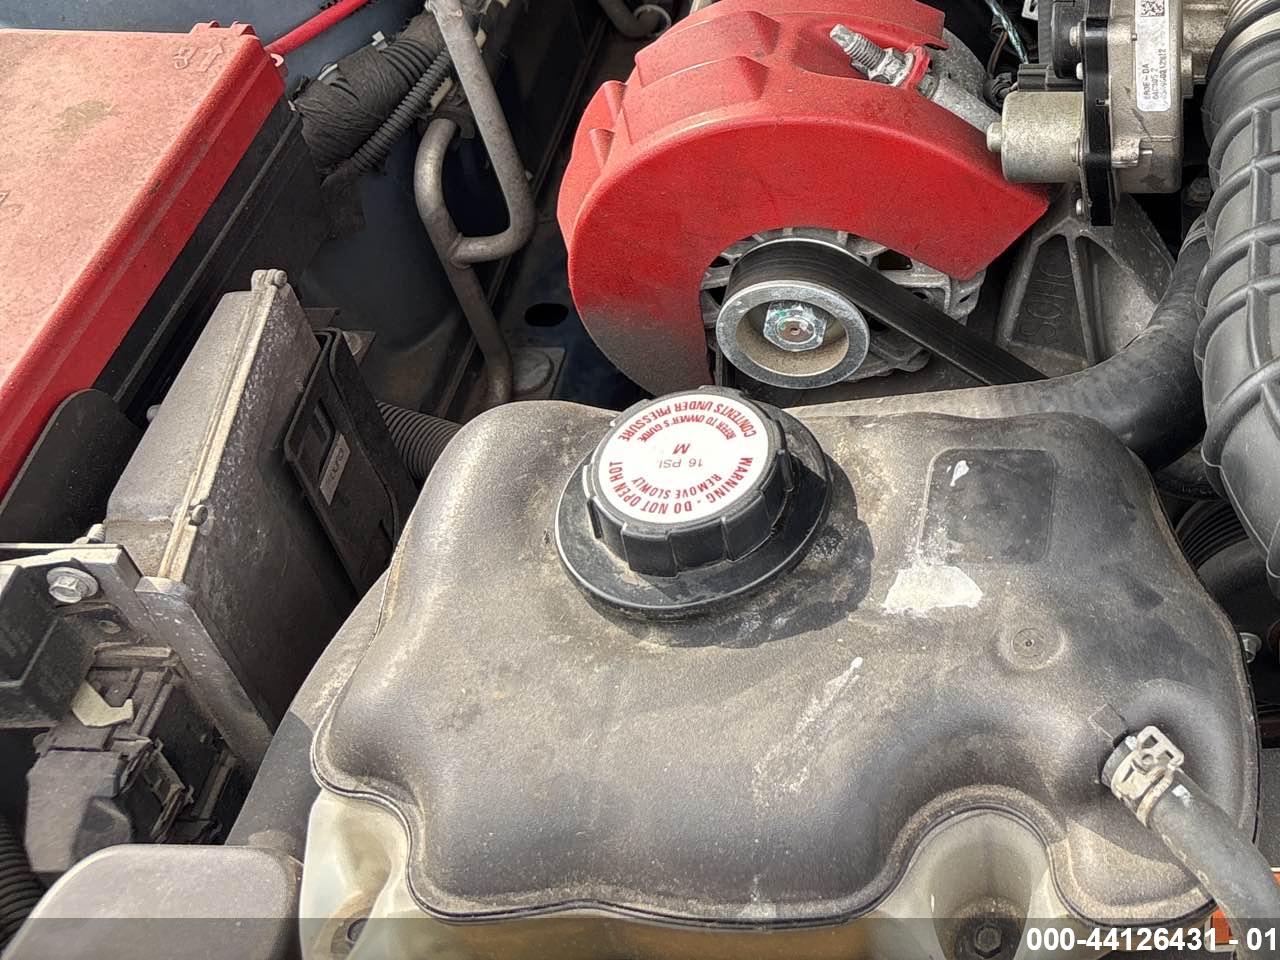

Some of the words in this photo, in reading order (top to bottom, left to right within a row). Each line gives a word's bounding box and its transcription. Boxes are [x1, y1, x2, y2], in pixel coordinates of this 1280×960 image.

[674, 401, 713, 413] UNDER
[618, 405, 672, 442] PRESSURE
[663, 415, 705, 428] OWNER'S
[705, 417, 719, 425] TO
[714, 403, 757, 438] CONTENTS
[638, 424, 663, 442] GUIDE
[716, 422, 737, 440] REFER
[672, 442, 691, 454] M
[608, 460, 624, 483] HOT
[688, 457, 703, 468] 16
[631, 476, 671, 499] SLOWLY
[675, 473, 723, 499] REMOVE
[708, 456, 753, 504] WARNING
[613, 482, 642, 507] OPEN
[640, 499, 669, 515] NOT
[674, 500, 693, 514] DO
